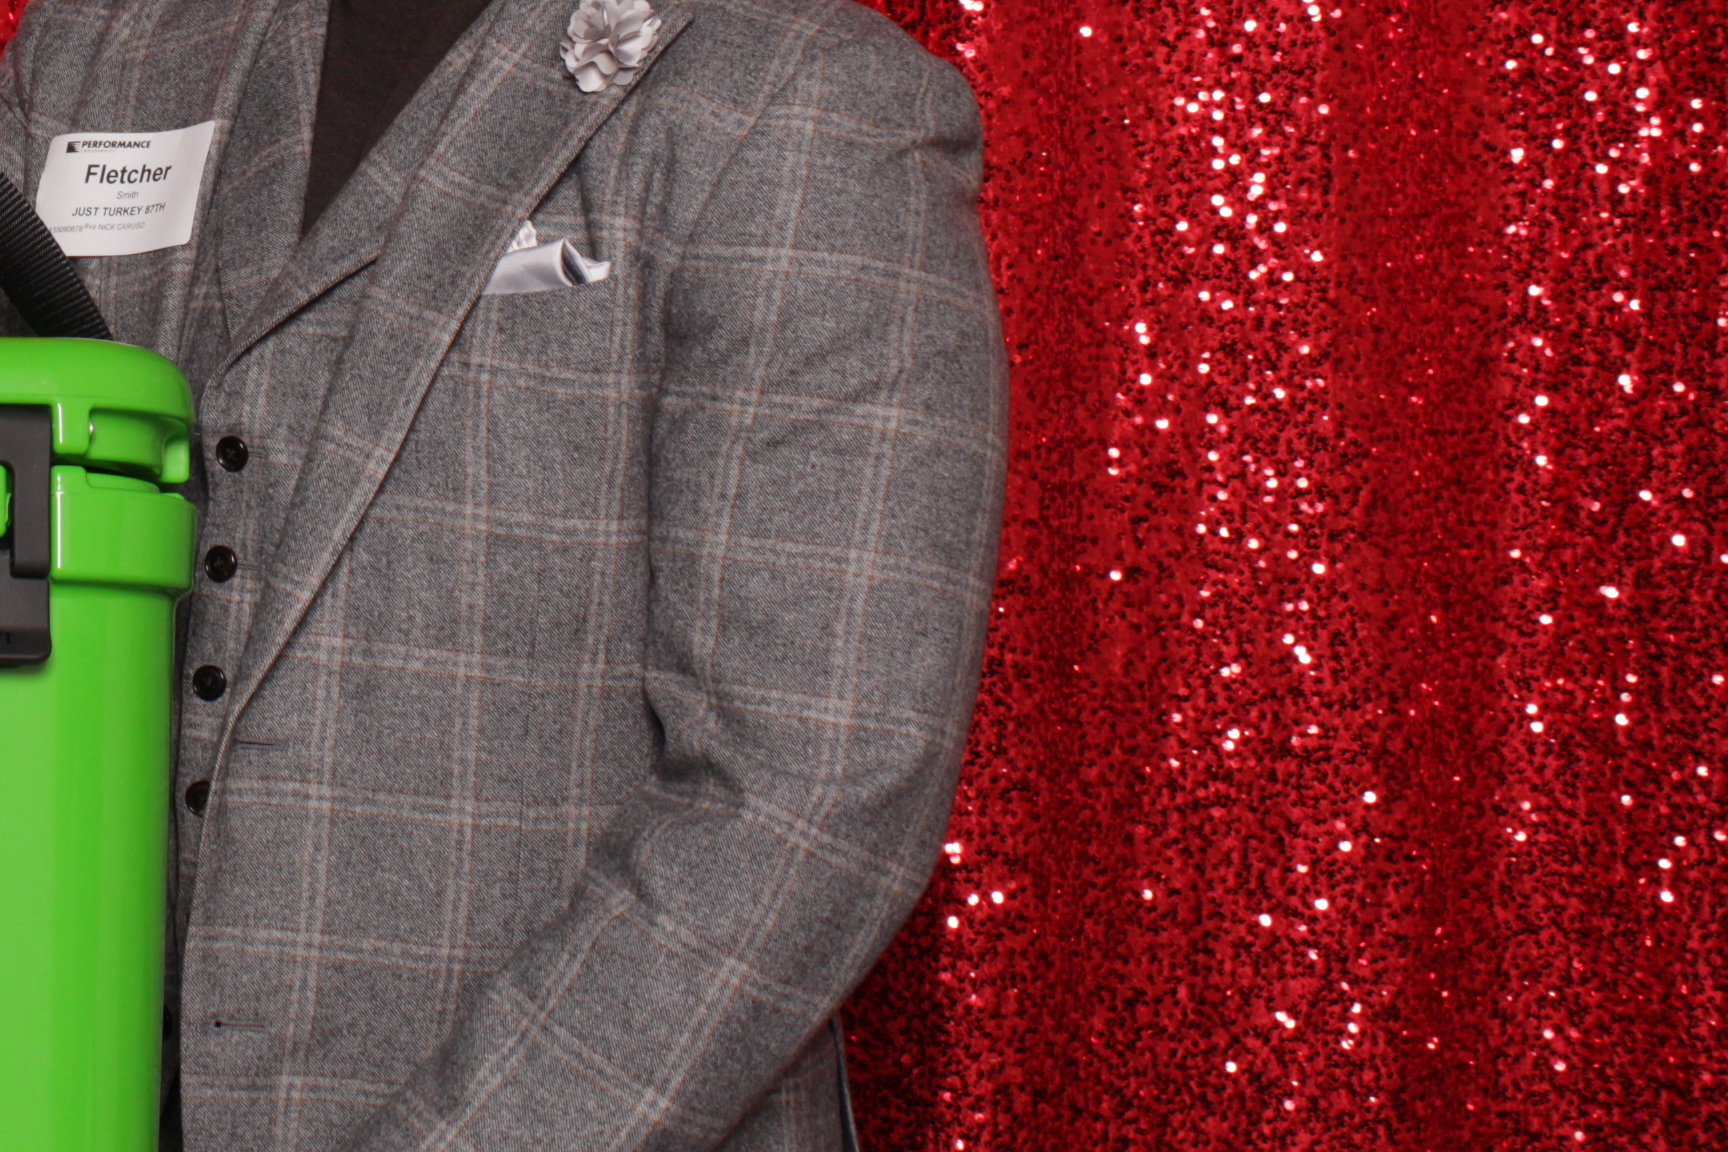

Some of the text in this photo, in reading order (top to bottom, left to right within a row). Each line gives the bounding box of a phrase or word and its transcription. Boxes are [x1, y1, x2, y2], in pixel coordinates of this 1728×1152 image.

[81, 140, 151, 149] PERFORMANCE
[84, 164, 172, 184] Fletcher
[116, 190, 139, 200] Smith
[71, 202, 166, 217] JUST TURKEY 87TH
[84, 222, 97, 231] Rep
[98, 223, 116, 231] NICK
[117, 221, 146, 231] CARUSO
